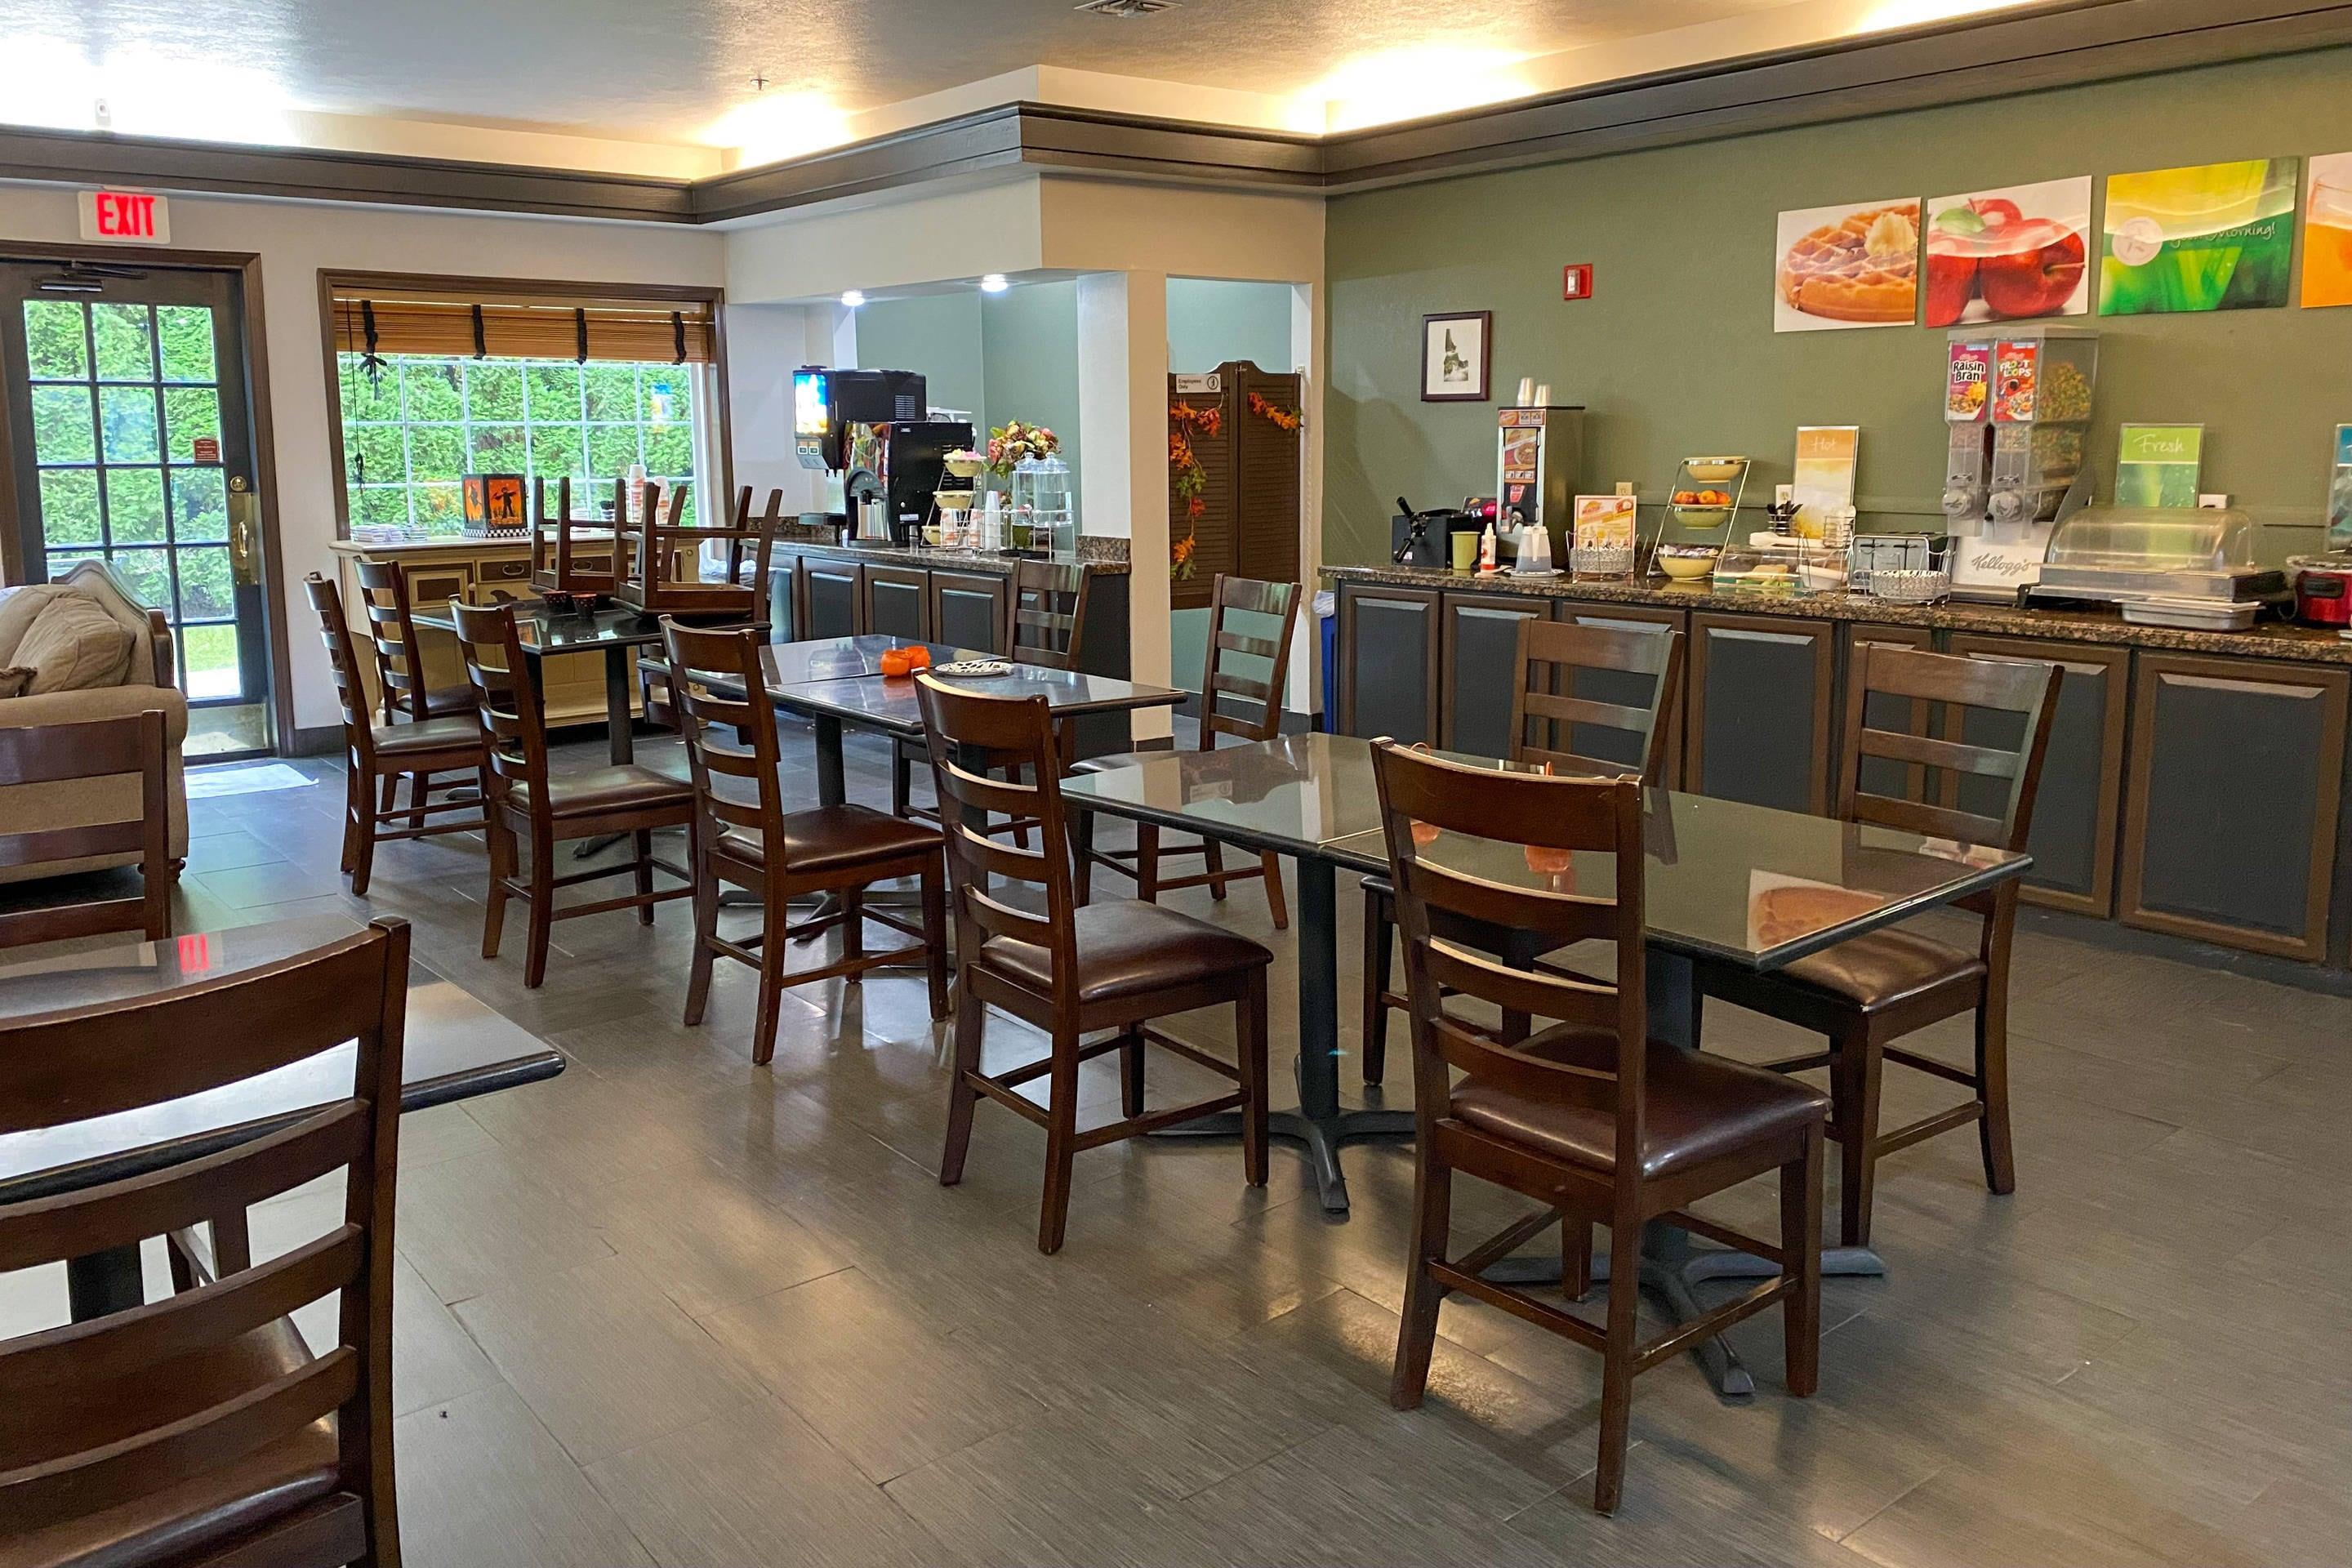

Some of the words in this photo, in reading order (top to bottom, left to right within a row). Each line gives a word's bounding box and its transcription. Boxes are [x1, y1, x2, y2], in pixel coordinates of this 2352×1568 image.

[96, 193, 155, 236] EXIT
[1953, 361, 1984, 372] Raisin
[1999, 359, 2030, 372] FROOT
[2003, 368, 2032, 377] LOOPS
[1955, 371, 1980, 381] Bran
[1810, 435, 1837, 452] Hot
[2132, 434, 2184, 452] Fresh
[1971, 553, 2032, 576] Kellogg's
